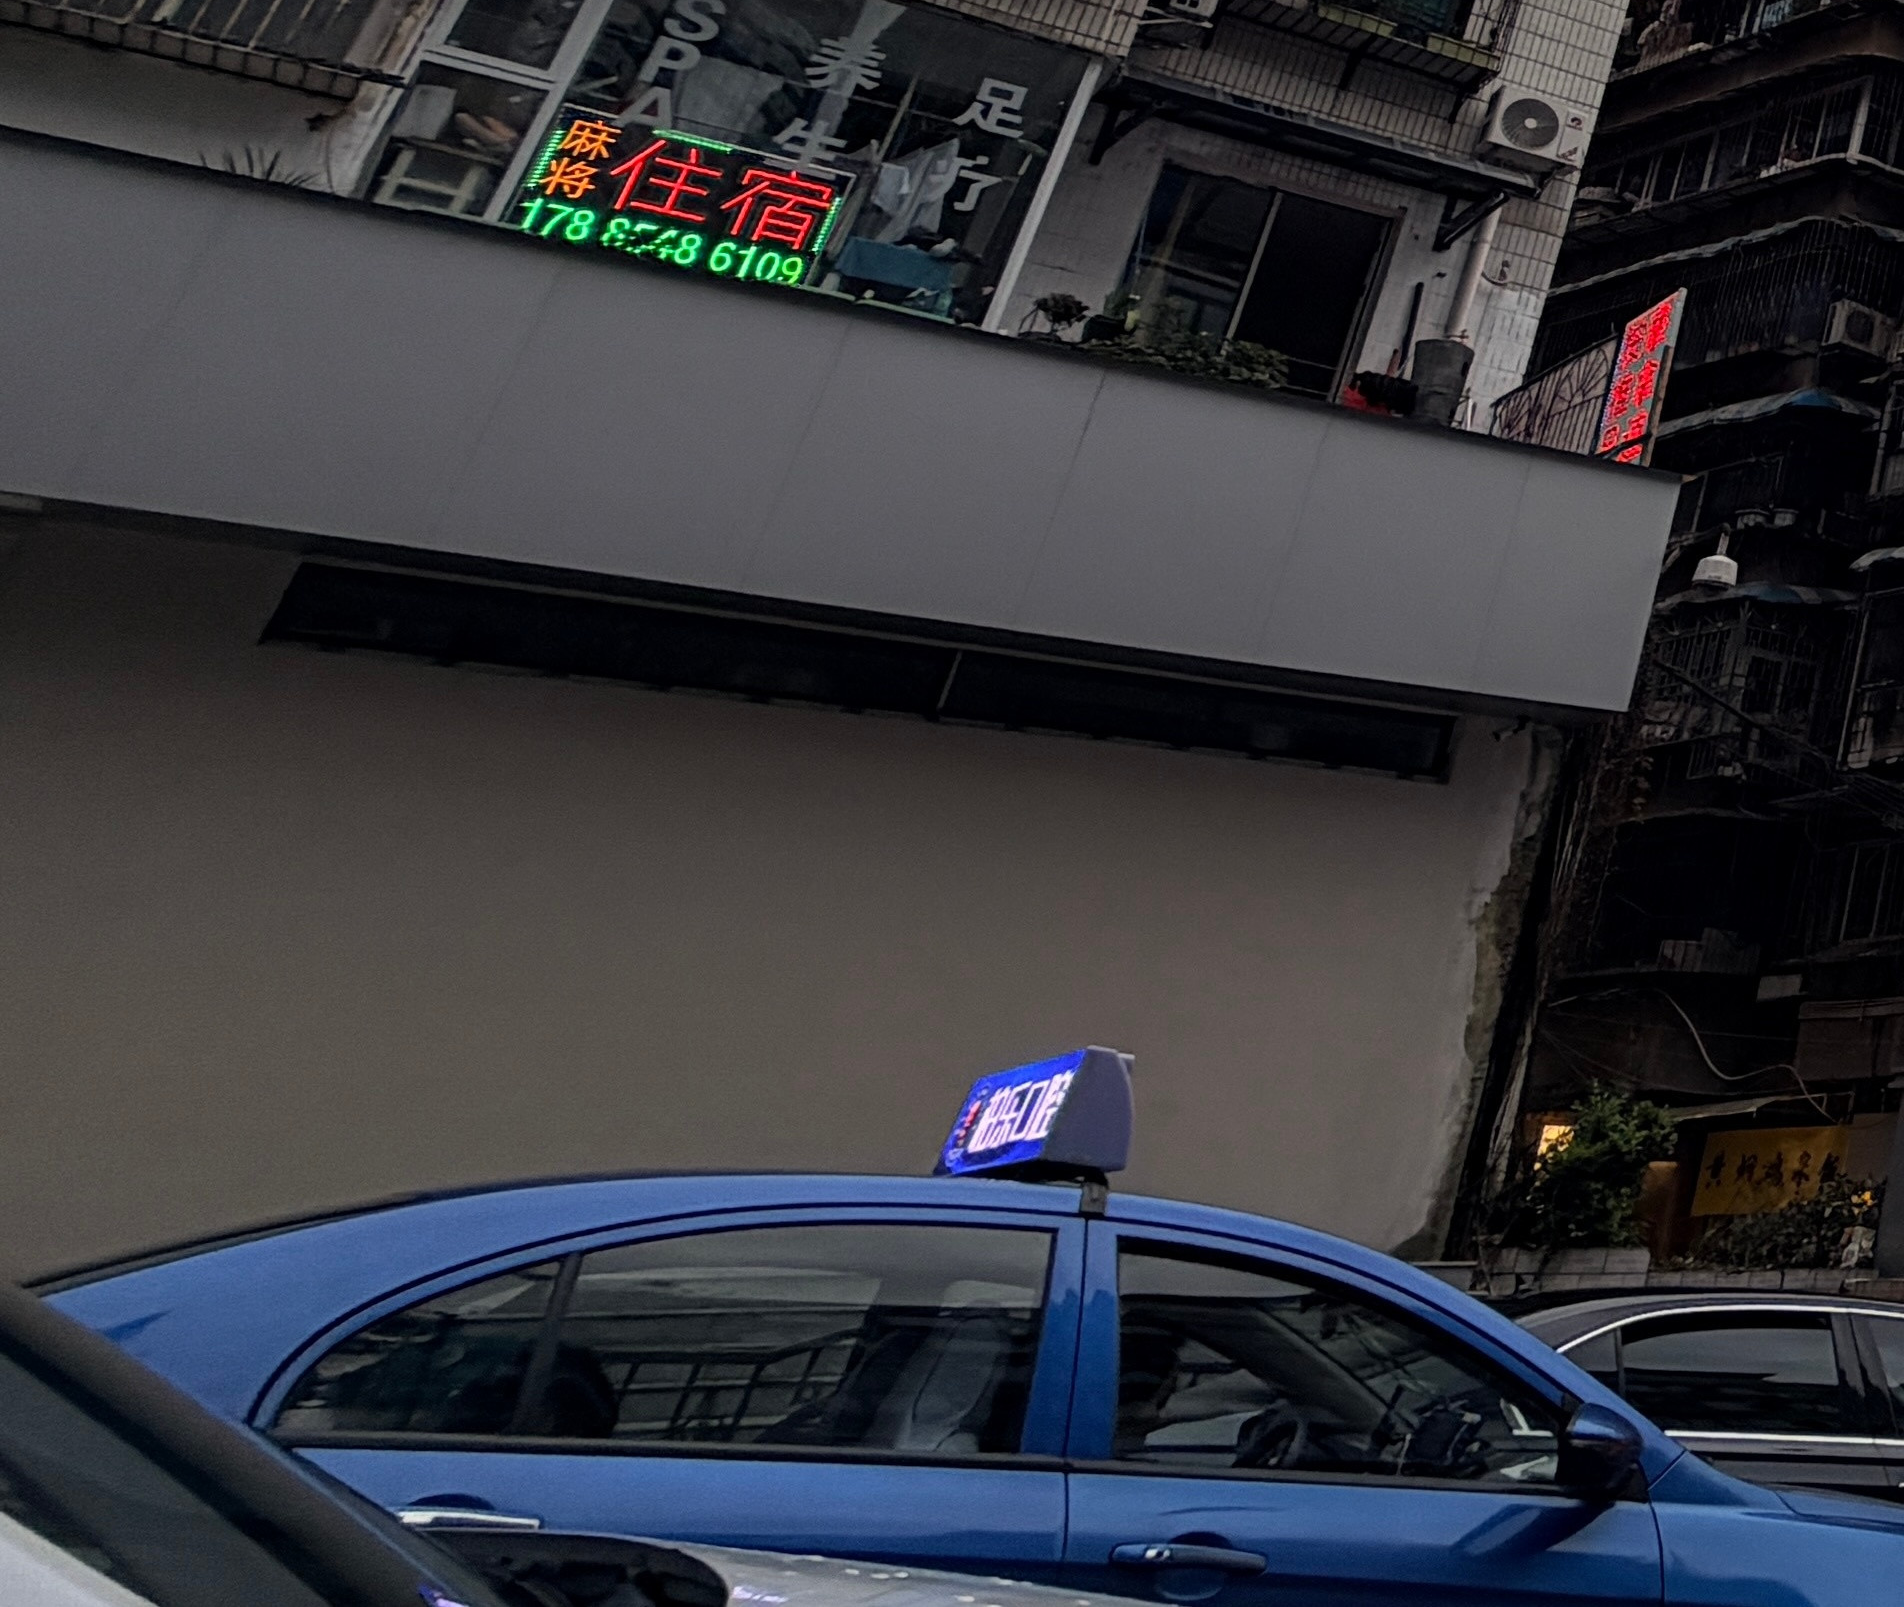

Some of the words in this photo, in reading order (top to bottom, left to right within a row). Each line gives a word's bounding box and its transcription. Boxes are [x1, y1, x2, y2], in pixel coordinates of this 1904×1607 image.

[773, 36, 886, 174] 养生
[540, 119, 622, 199] 麻将
[607, 138, 834, 251] 住宿
[520, 197, 596, 243] 178
[709, 242, 805, 287] 6109
